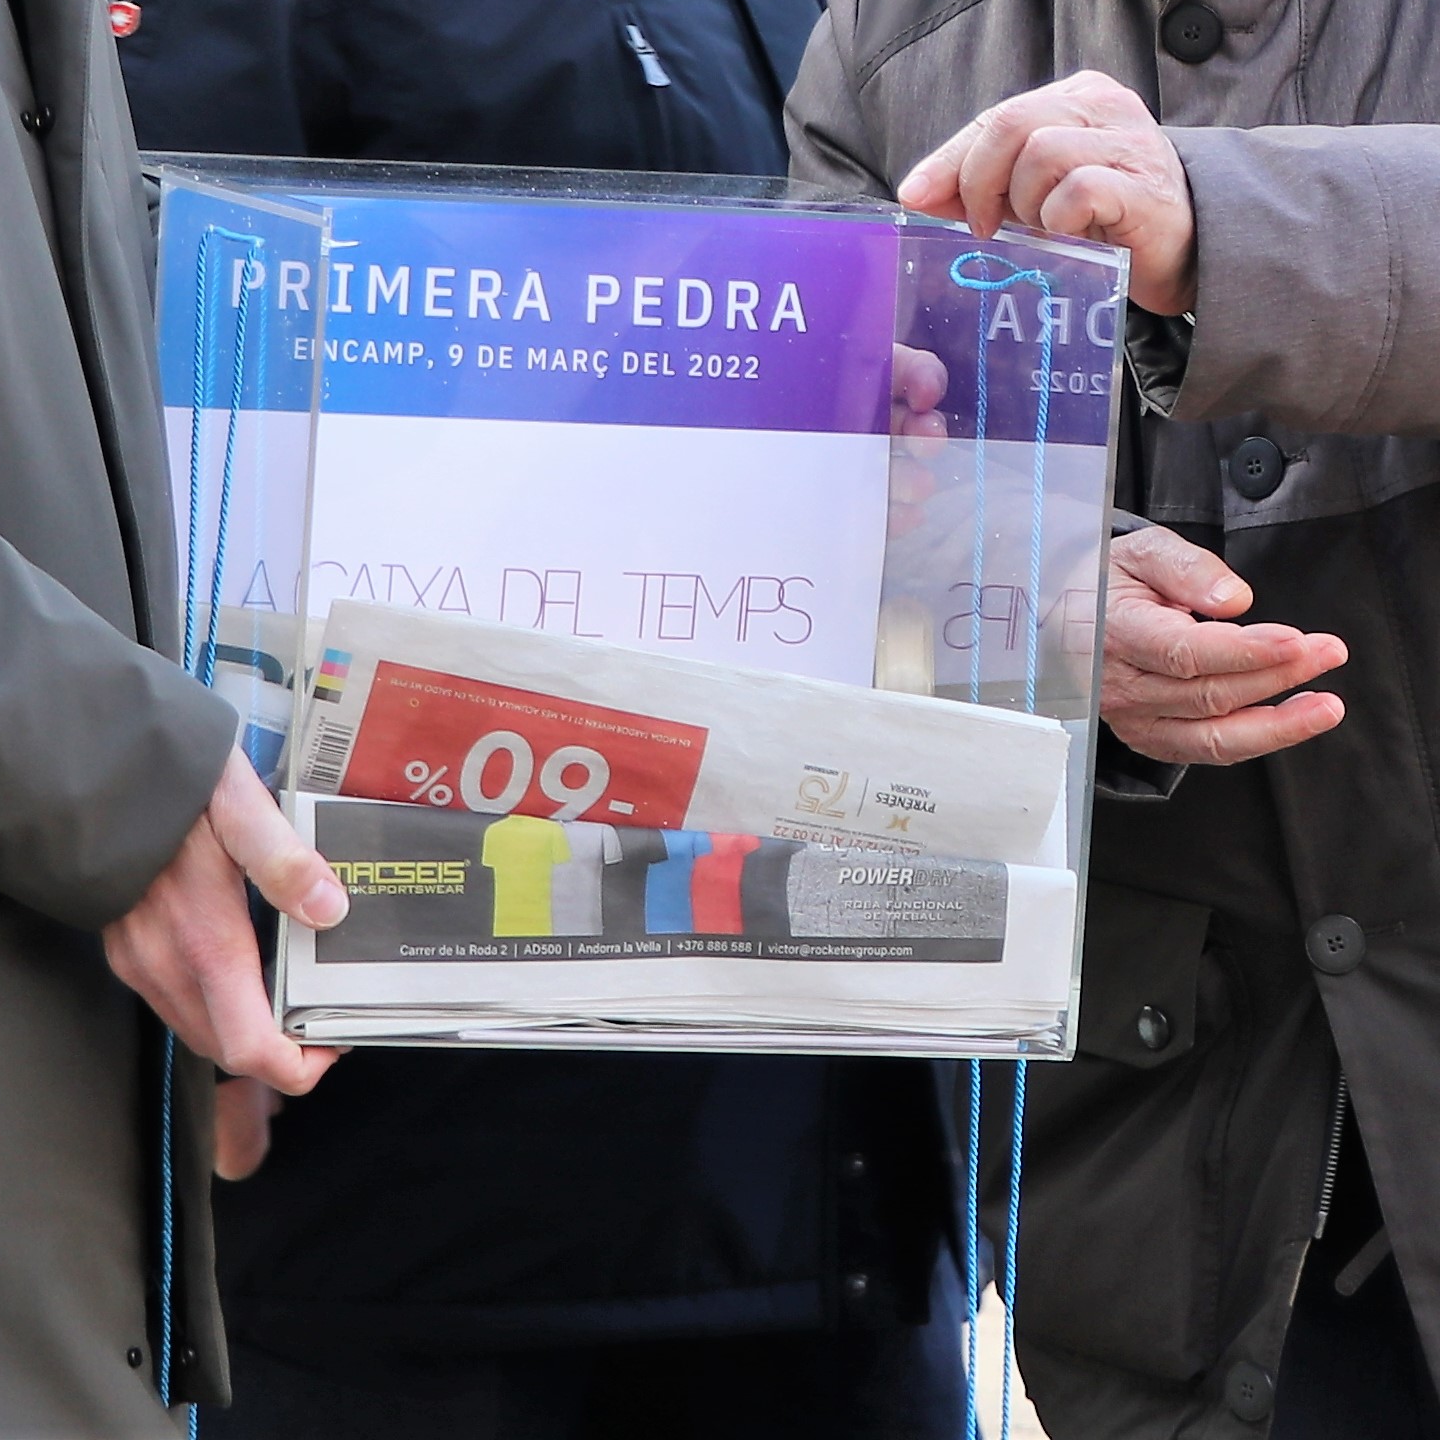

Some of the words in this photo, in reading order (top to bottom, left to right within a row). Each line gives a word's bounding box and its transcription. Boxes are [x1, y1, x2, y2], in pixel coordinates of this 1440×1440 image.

[231, 258, 551, 322] PRIMERA
[586, 273, 809, 333] PEDRA
[293, 336, 435, 370] ENCAMP,
[448, 343, 464, 367] 9
[477, 344, 513, 370] DE
[527, 347, 610, 379] MARÇ
[622, 351, 676, 377] DEL
[688, 353, 760, 380] 2022
[623, 571, 815, 644] TEMPS
[794, 771, 850, 819] 75
[875, 791, 937, 814] PYRÉNÉES
[348, 884, 465, 895] RKSPORTSWEAR
[885, 900, 963, 910] FUNCIONAL
[885, 911, 944, 921] TREBALL
[399, 943, 437, 957] Carrer
[439, 943, 453, 956] de
[456, 943, 466, 956] la
[469, 943, 498, 956] Roda
[500, 943, 509, 956] 2
[523, 942, 563, 955] AD500
[578, 941, 621, 955] Andorra
[623, 940, 634, 953] la
[635, 940, 662, 954] Vella
[676, 939, 704, 952] +376
[767, 943, 913, 959] victor@rocketexgroup.com
